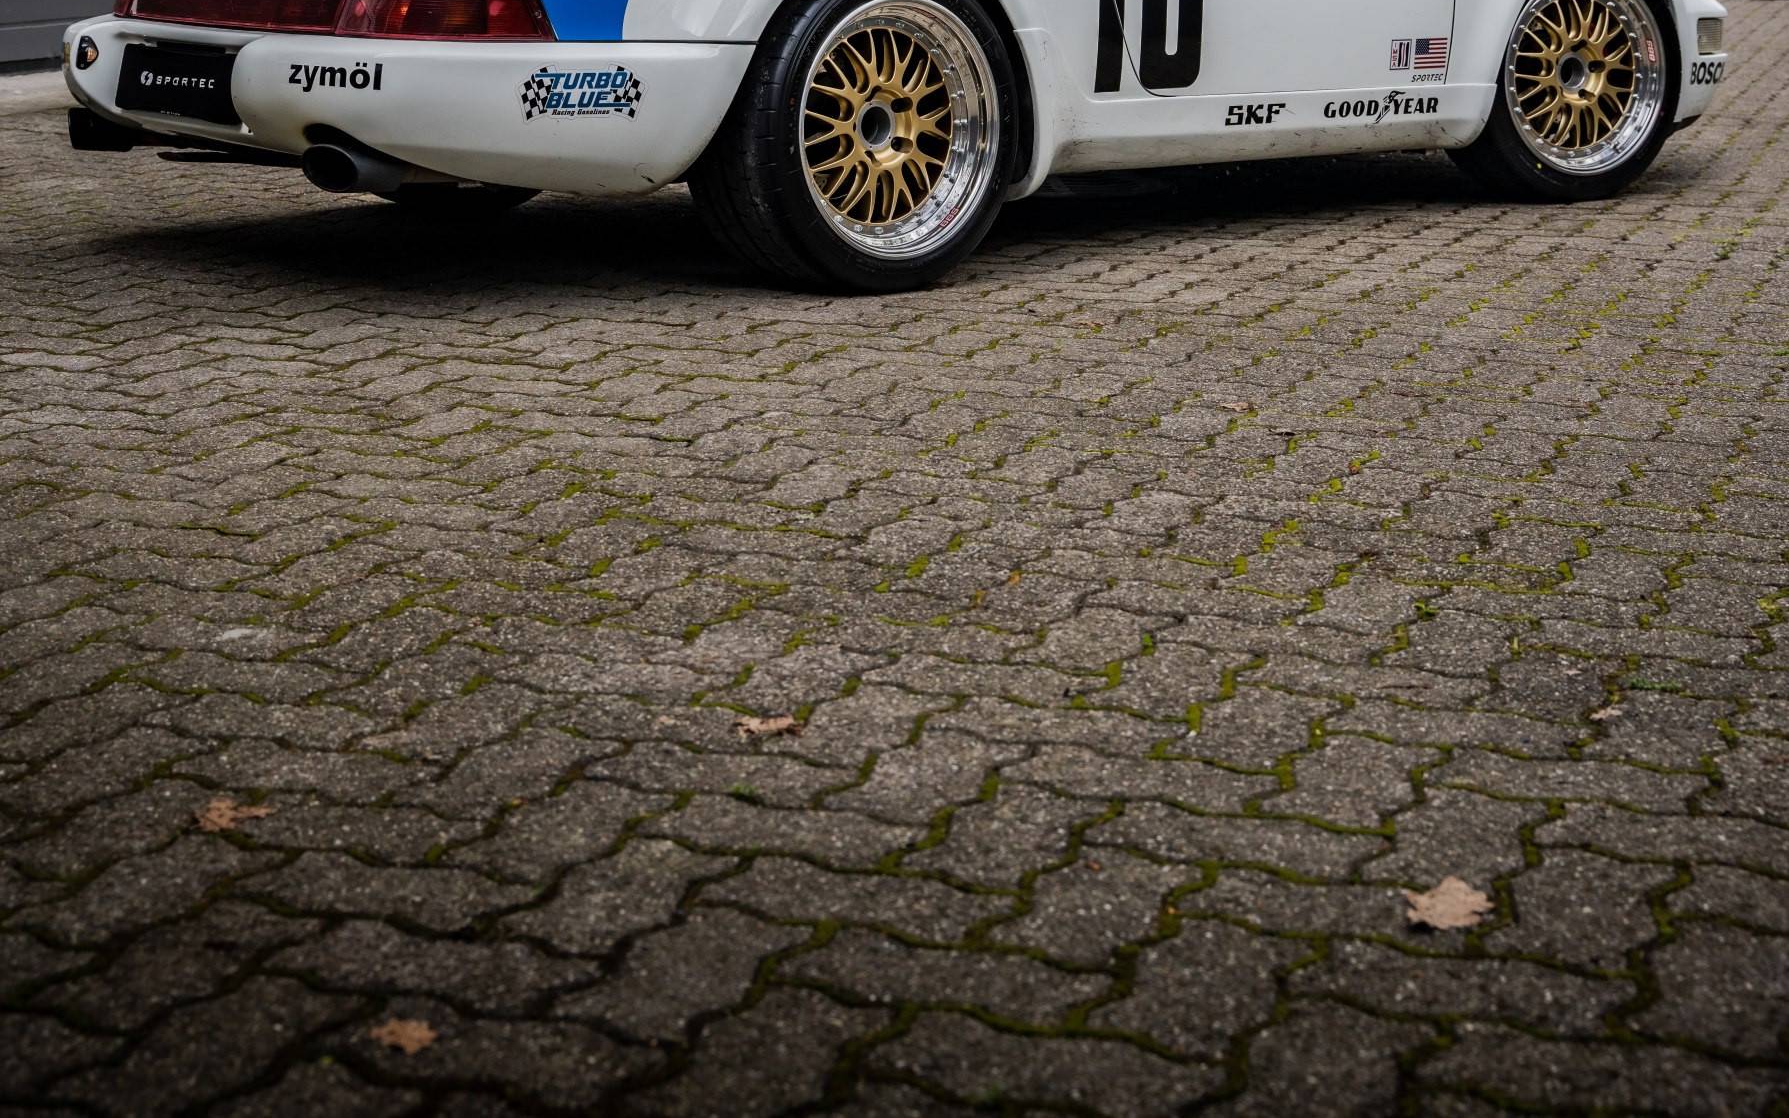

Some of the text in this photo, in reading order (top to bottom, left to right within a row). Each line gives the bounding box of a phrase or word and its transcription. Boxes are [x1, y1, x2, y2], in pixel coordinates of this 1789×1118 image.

[155, 75, 215, 89] SPORTEC
[288, 62, 384, 92] zymöl
[535, 72, 628, 90] TURBO
[1690, 62, 1725, 85] BOSC
[545, 91, 631, 109] BLUE
[1324, 100, 1379, 119] GOOD
[1225, 103, 1286, 126] SKF
